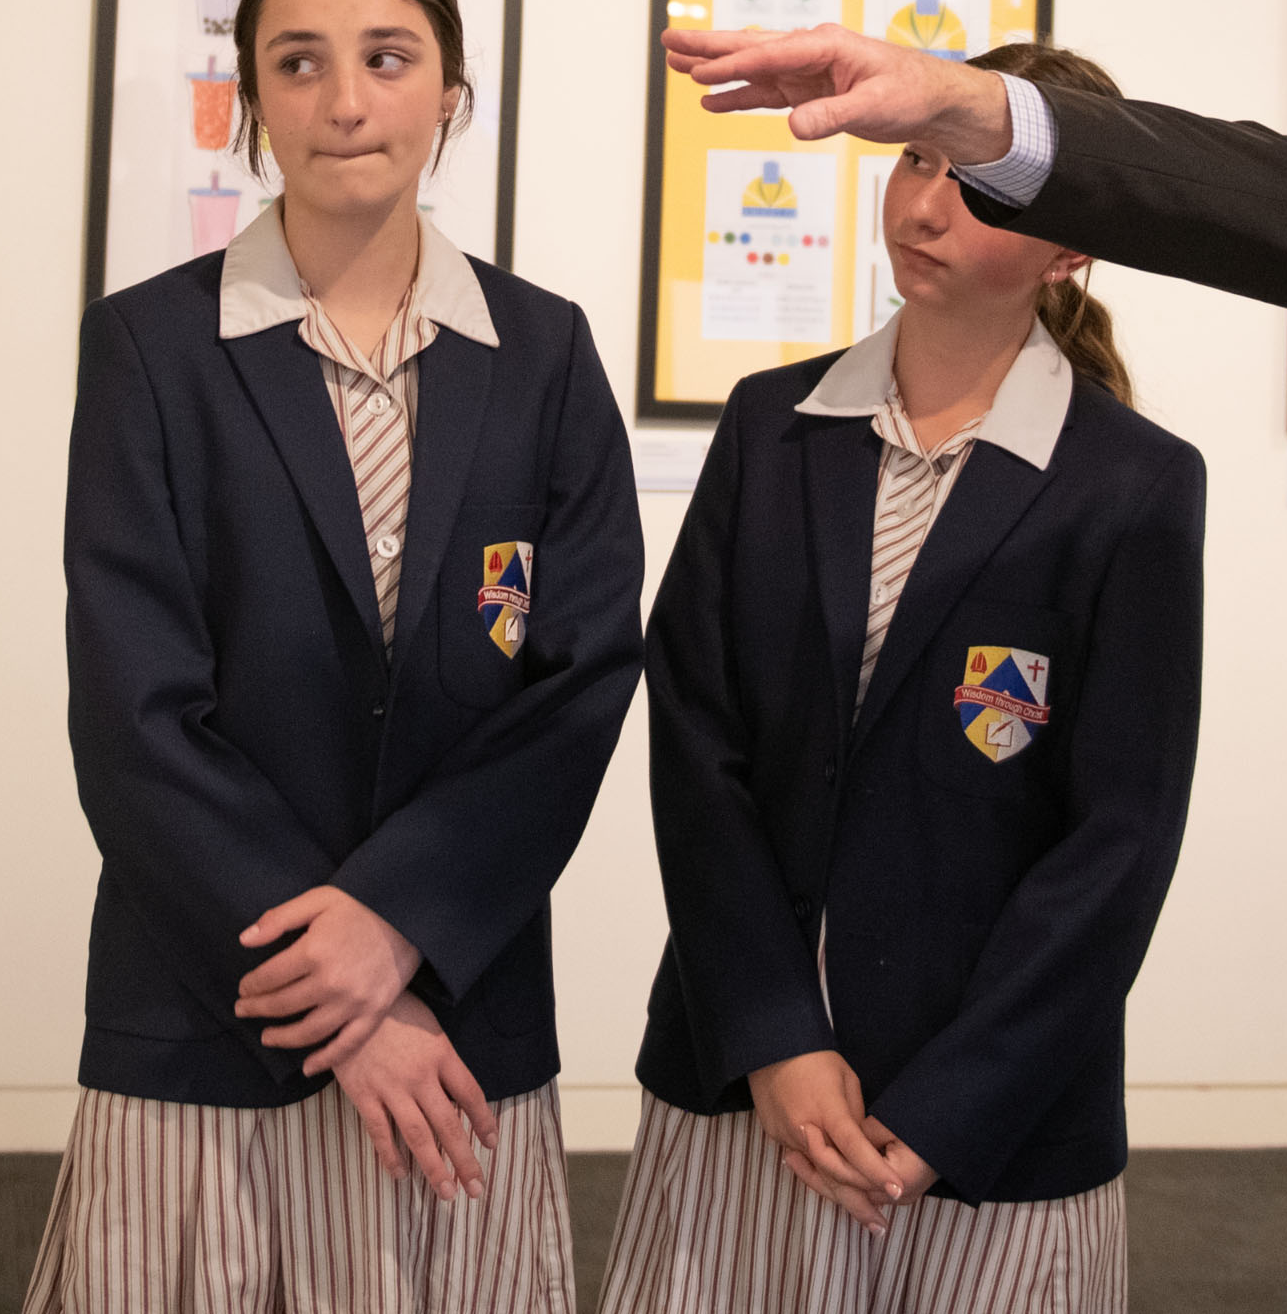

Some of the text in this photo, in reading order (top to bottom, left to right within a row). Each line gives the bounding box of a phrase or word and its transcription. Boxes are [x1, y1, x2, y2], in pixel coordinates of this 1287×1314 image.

[483, 589, 509, 601] Wisdom
[961, 688, 994, 703] Wisdom
[994, 695, 1023, 714] through
